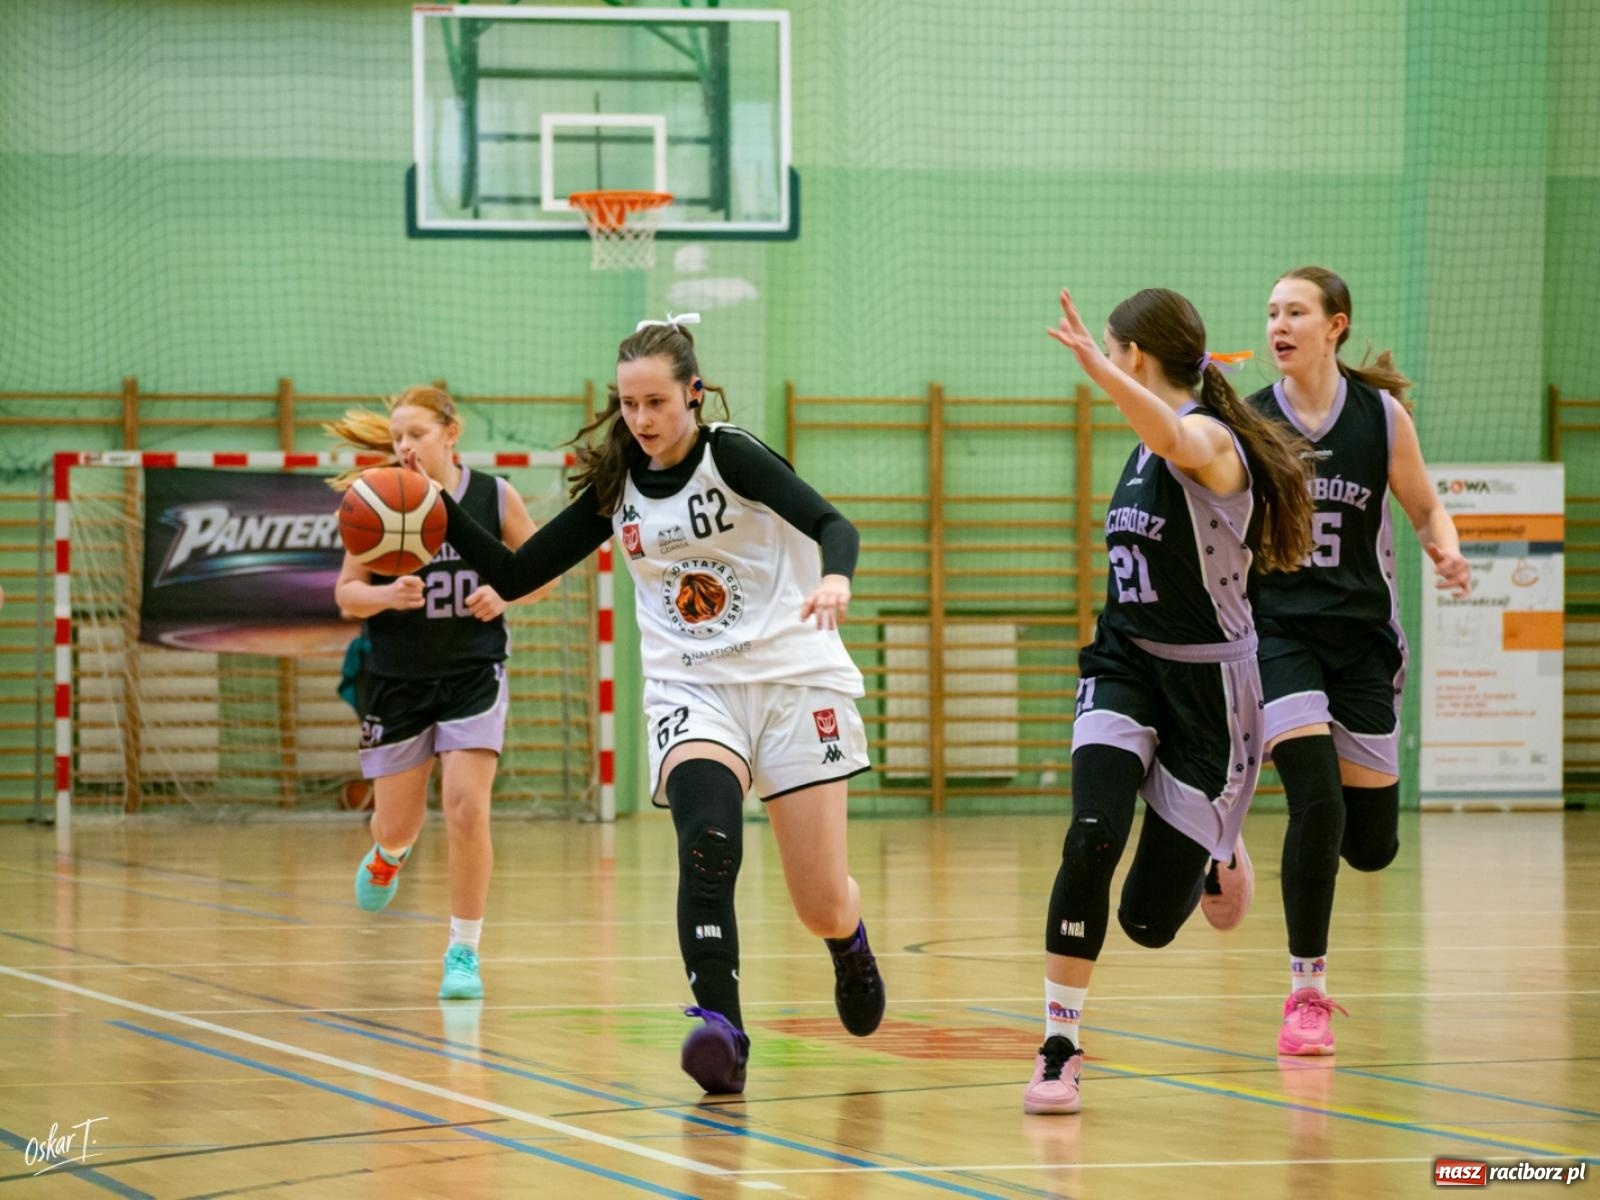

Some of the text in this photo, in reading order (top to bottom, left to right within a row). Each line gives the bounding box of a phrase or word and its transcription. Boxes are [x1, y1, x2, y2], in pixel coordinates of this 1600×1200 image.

[1437, 479, 1490, 495] SOWA
[167, 504, 344, 571] PANTER
[687, 487, 734, 540] 62
[1105, 503, 1166, 542] CIBÓRZ
[1302, 512, 1342, 567] 5
[426, 569, 480, 619] 20
[1109, 544, 1159, 604] 21
[657, 705, 690, 751] 62
[703, 925, 722, 939] NBA
[1067, 921, 1085, 938] NBA
